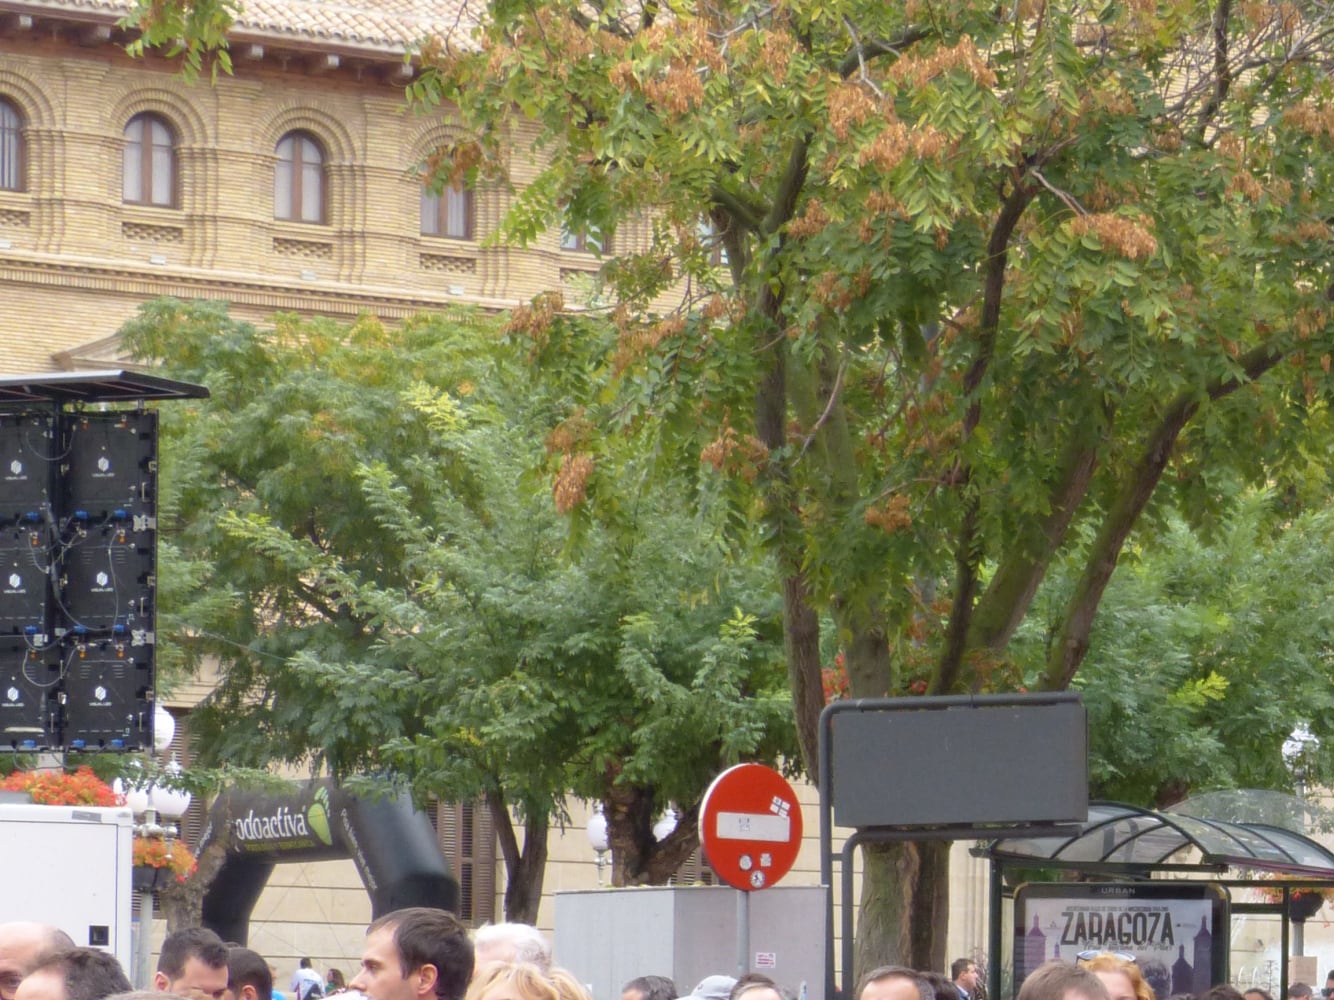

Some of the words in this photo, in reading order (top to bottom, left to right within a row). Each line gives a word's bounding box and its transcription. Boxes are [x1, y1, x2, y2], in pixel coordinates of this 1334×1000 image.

[230, 805, 309, 842] odoactiva
[1101, 887, 1136, 895] URBAN
[1061, 911, 1174, 946] ZARAGOZA
